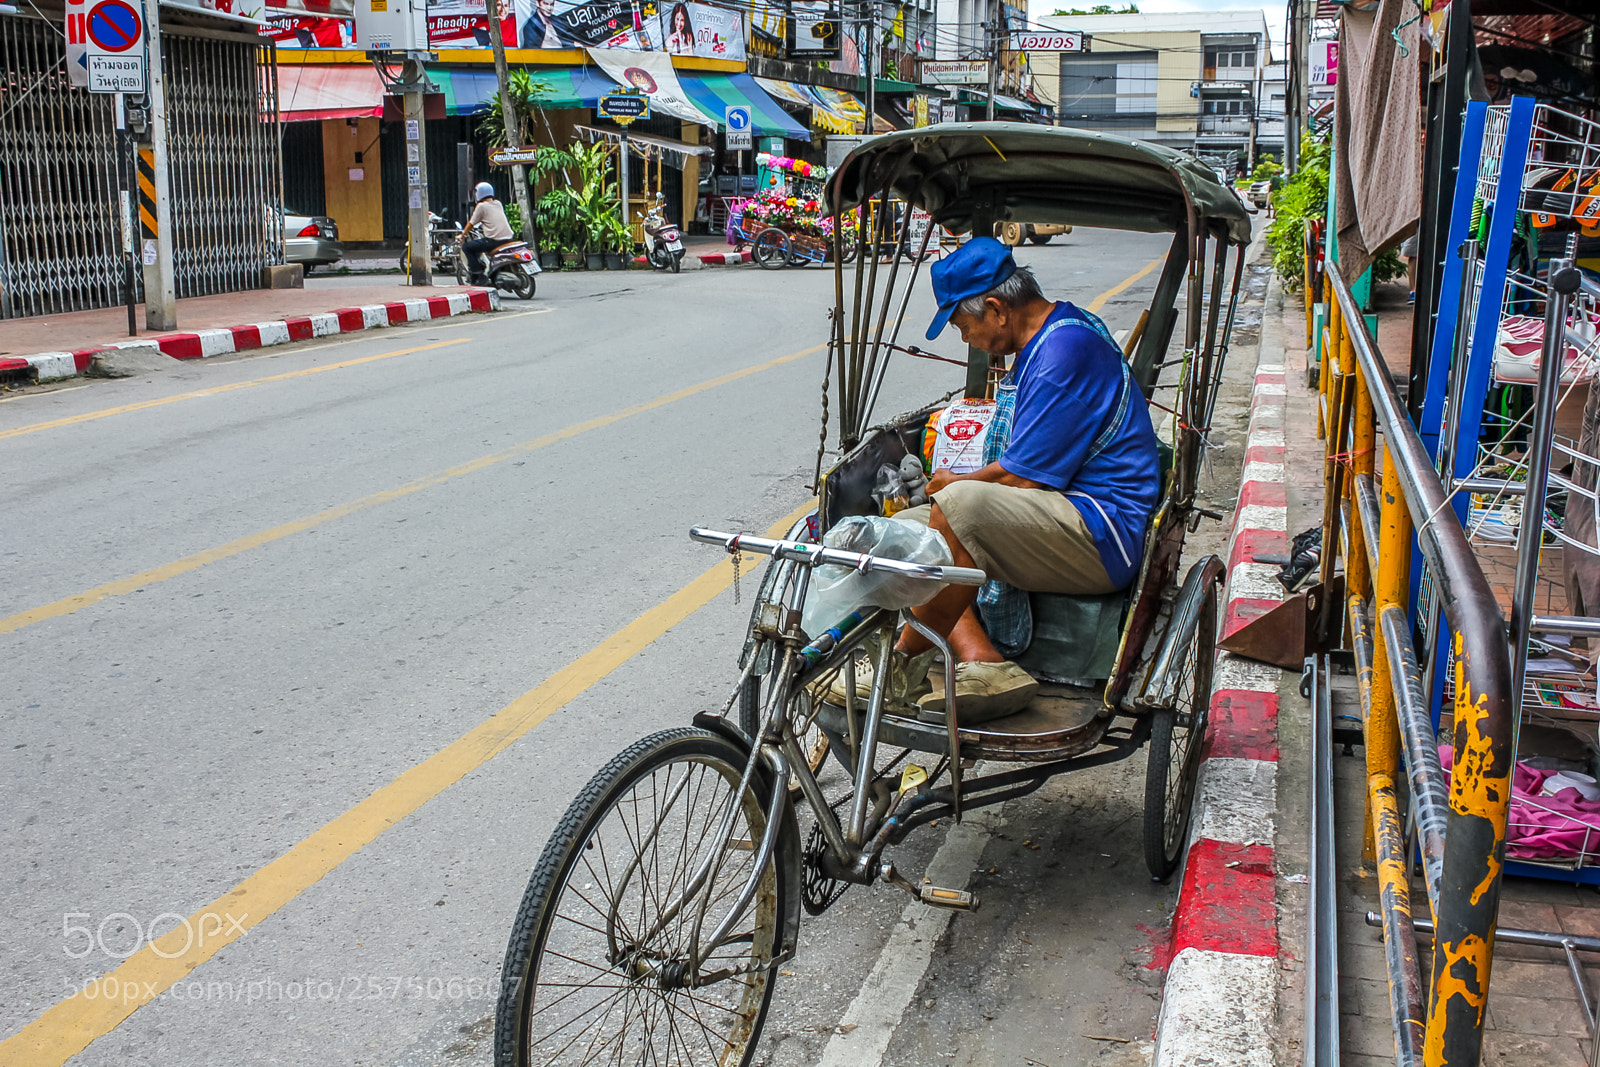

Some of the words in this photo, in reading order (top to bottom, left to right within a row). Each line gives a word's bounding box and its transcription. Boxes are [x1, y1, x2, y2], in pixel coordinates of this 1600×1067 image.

[1021, 36, 1075, 49] เอมอร
[93, 57, 139, 70] ห้ามจอด
[96, 73, 120, 92] วันคู่
